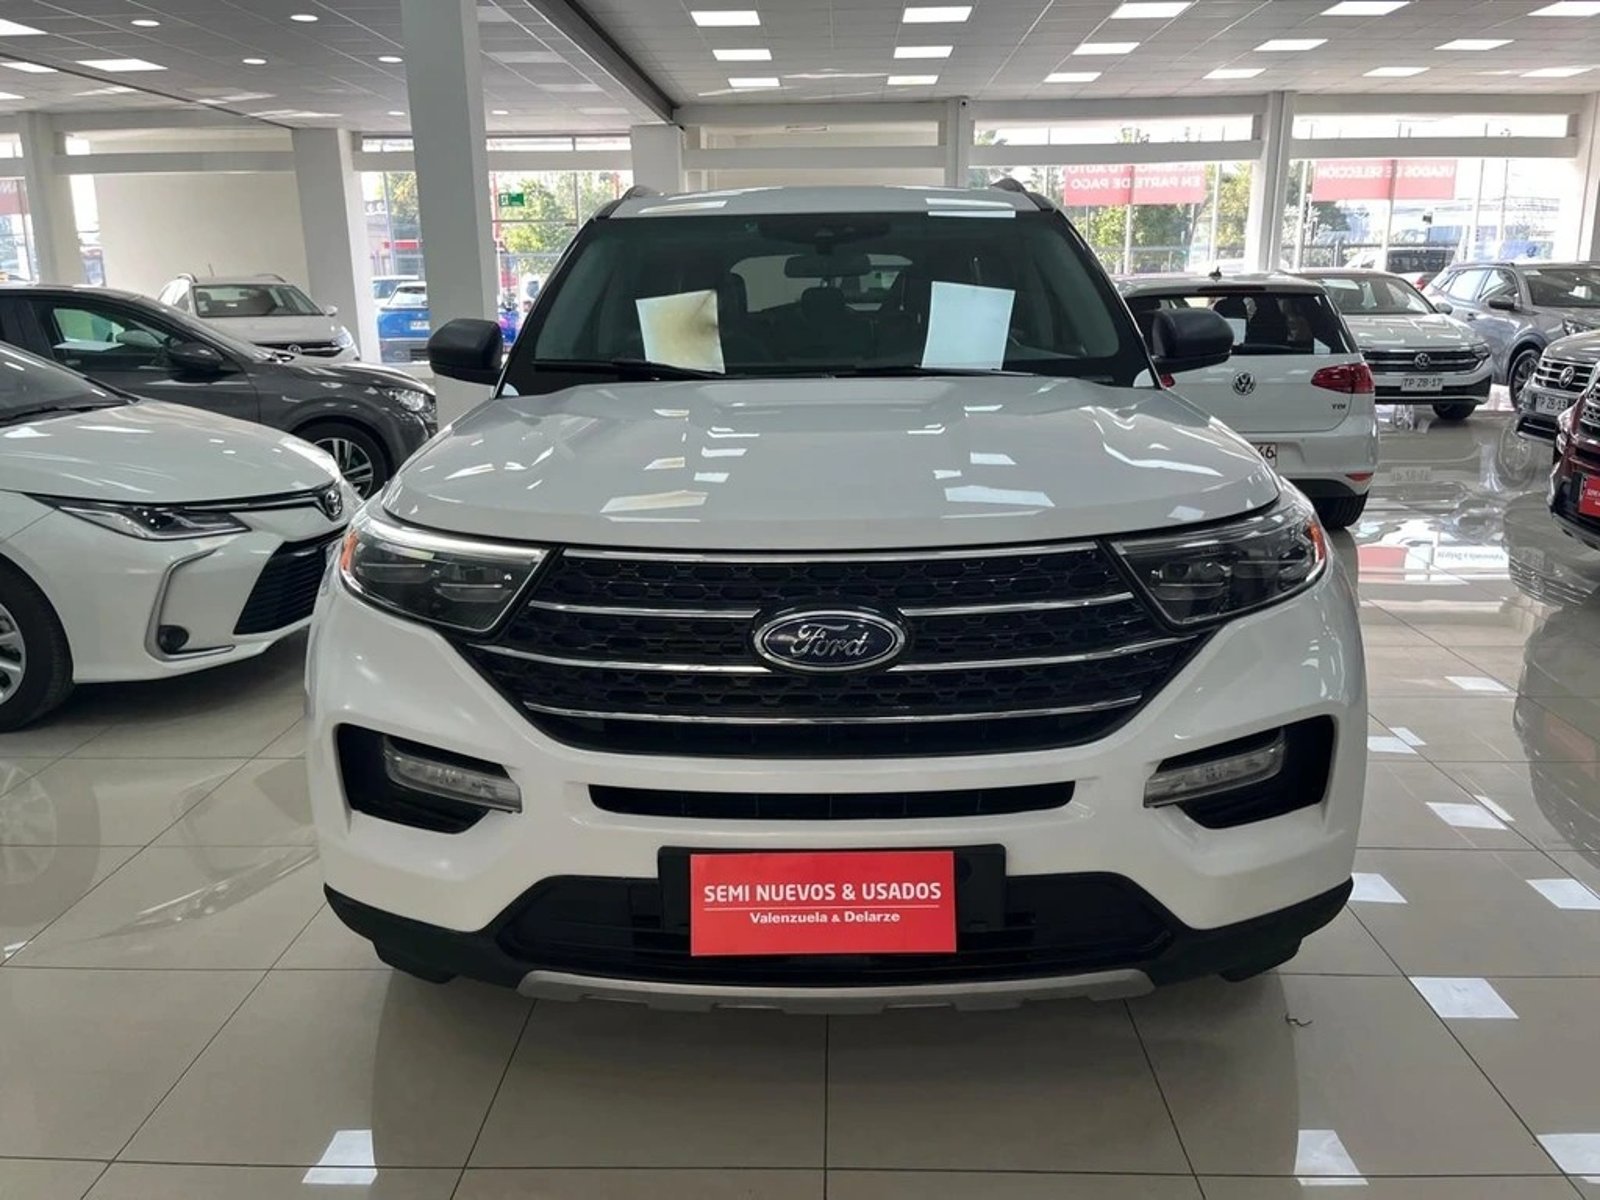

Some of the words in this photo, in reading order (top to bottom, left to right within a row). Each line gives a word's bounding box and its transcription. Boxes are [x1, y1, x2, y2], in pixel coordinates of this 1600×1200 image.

[790, 623, 869, 657] Ford
[704, 884, 749, 903] SEMI
[755, 883, 836, 902] NUEVOS
[841, 883, 856, 901] &
[861, 882, 942, 901] USADOS
[749, 911, 828, 924] Valenzuela
[831, 914, 841, 924] &
[843, 910, 901, 923] Delarze
